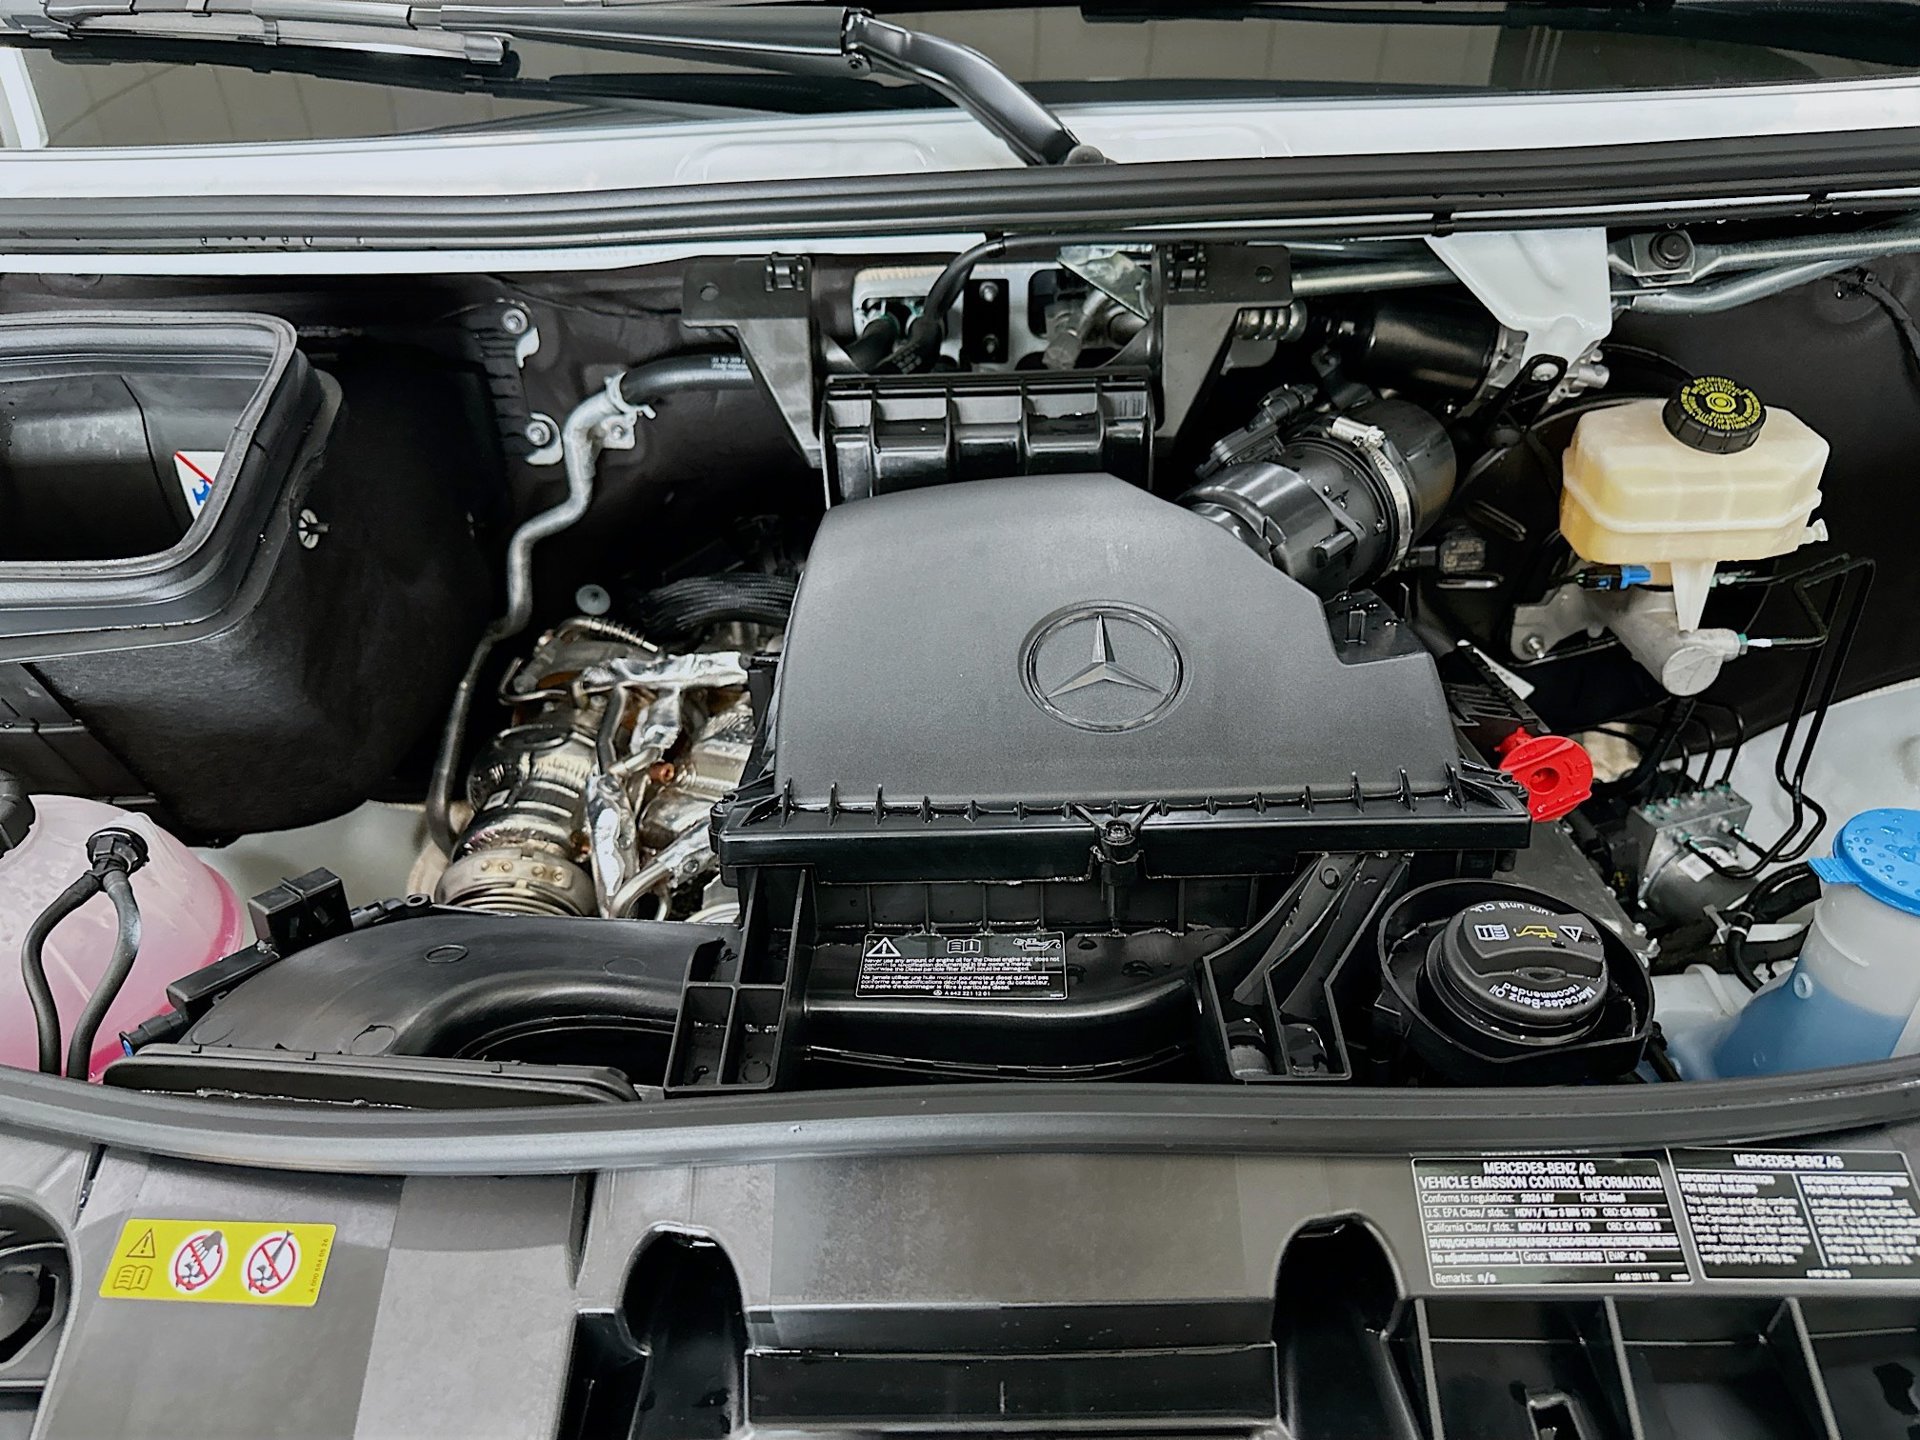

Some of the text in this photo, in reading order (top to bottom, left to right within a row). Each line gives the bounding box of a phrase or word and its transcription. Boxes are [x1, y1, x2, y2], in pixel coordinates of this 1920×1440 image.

[1489, 984, 1597, 1010] Mercedes-Benz Oil
[1502, 981, 1581, 1000] recommended
[1482, 1161, 1597, 1175] MERCEDES-BENZ AG
[1733, 1154, 1844, 1169] MERCEDES-BENZ AG
[1419, 1176, 1663, 1189] VEHICLE EMISSION CONTROL INFORMATION
[1421, 1193, 1460, 1203] Conforms
[1460, 1193, 1471, 1203] to
[1424, 1208, 1442, 1218] U.S.
[1442, 1208, 1460, 1218] EPA
[1426, 1222, 1464, 1233] California
[1435, 1273, 1473, 1283] Remarks:
